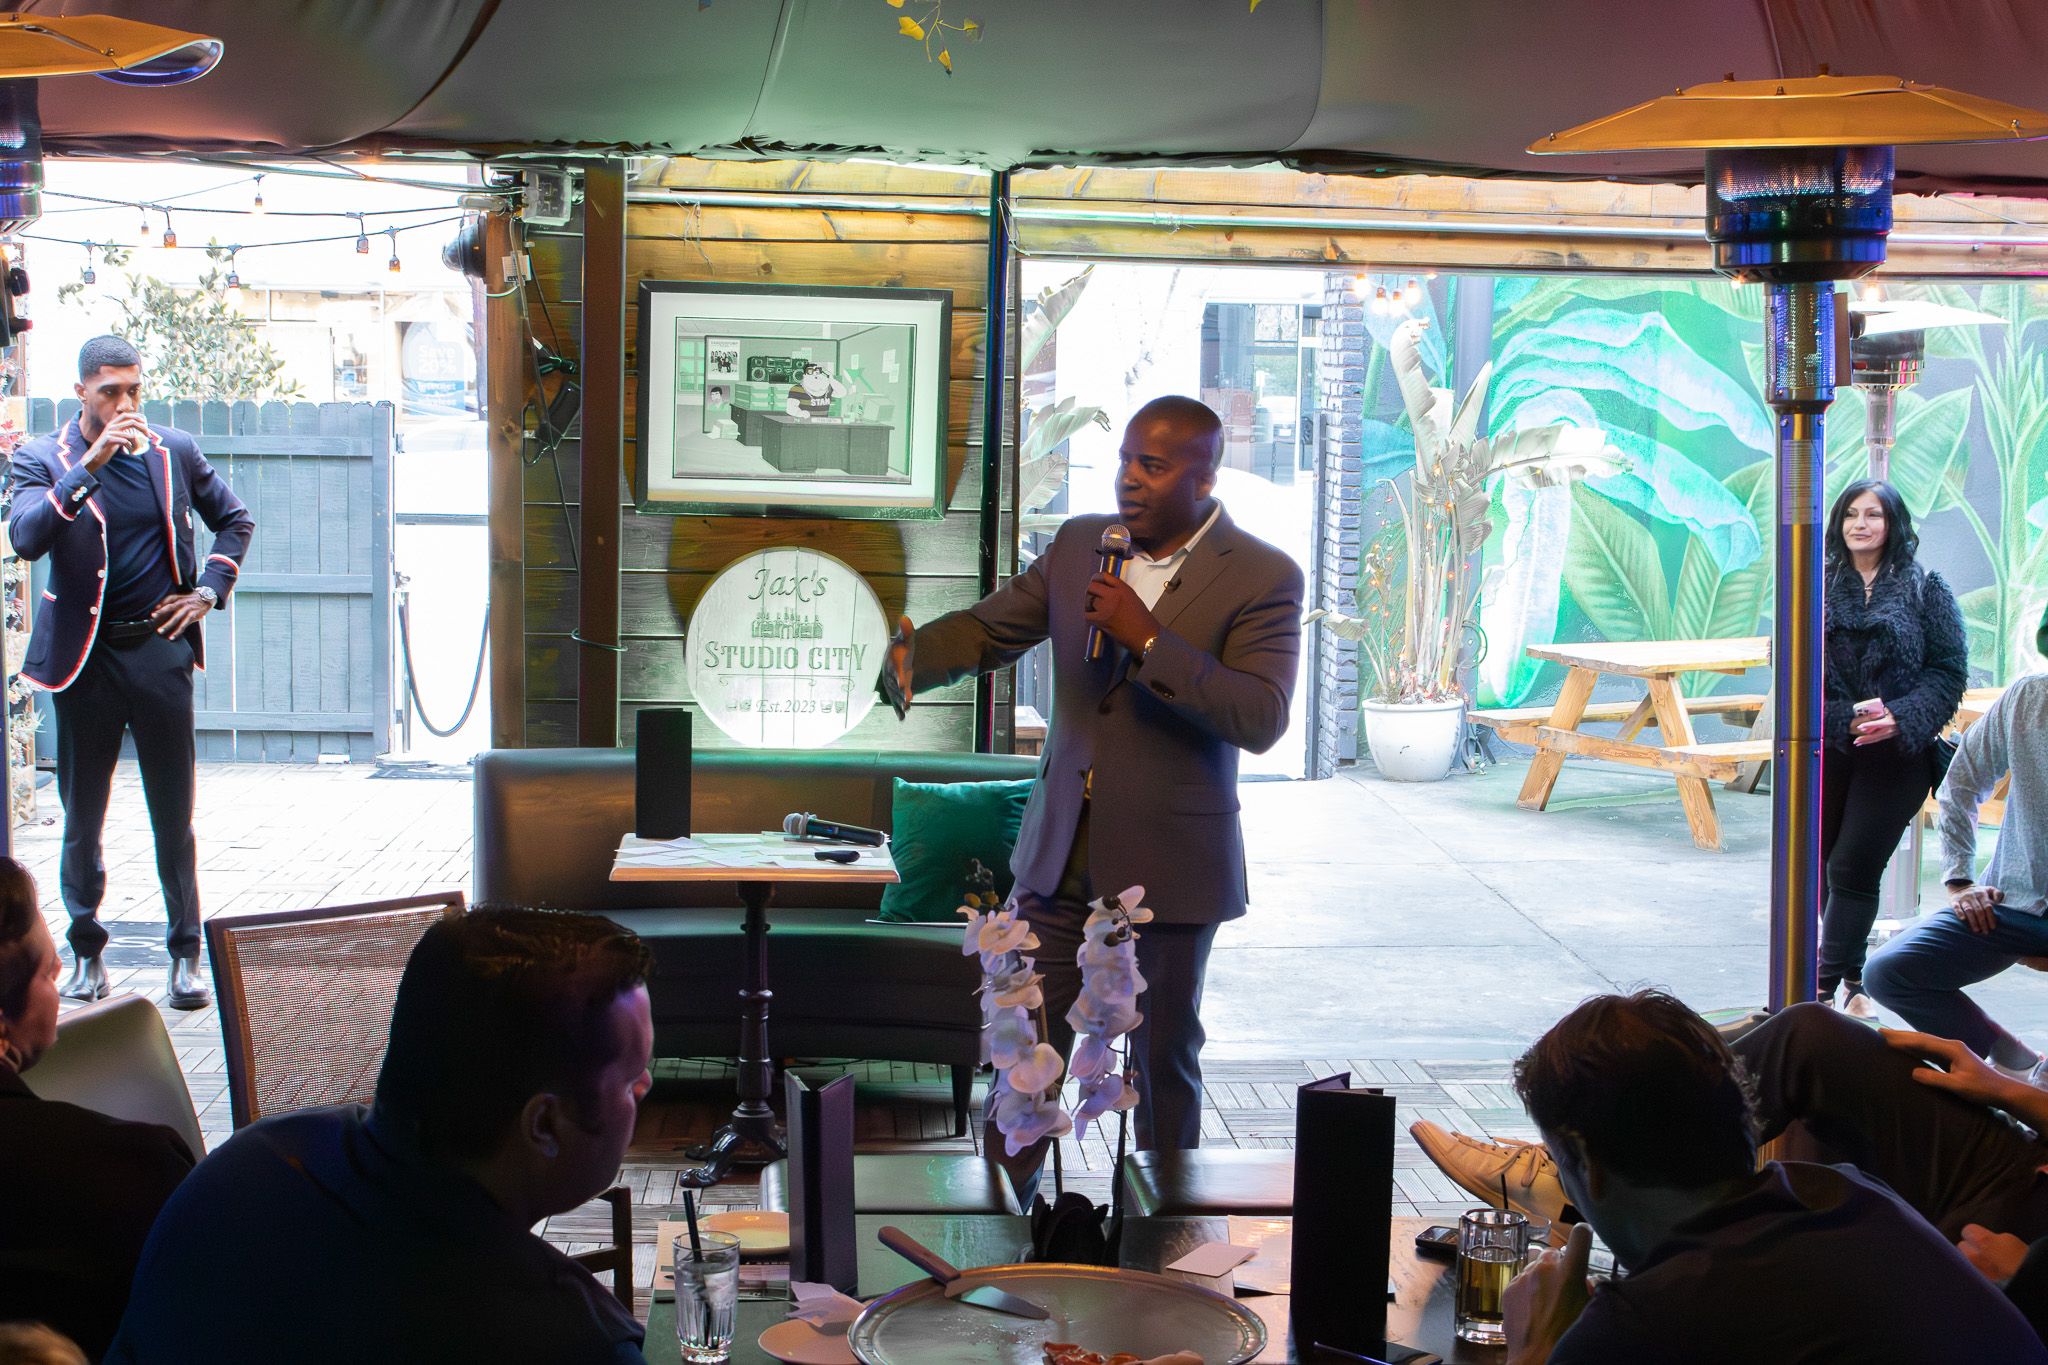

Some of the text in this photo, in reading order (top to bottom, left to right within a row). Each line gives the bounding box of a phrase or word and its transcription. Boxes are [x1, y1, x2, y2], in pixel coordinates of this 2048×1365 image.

[418, 344, 456, 358] Save
[418, 359, 457, 374] 20%
[810, 398, 831, 407] STAN
[748, 568, 829, 603] Jax's
[703, 641, 868, 671] STUDIO CITY
